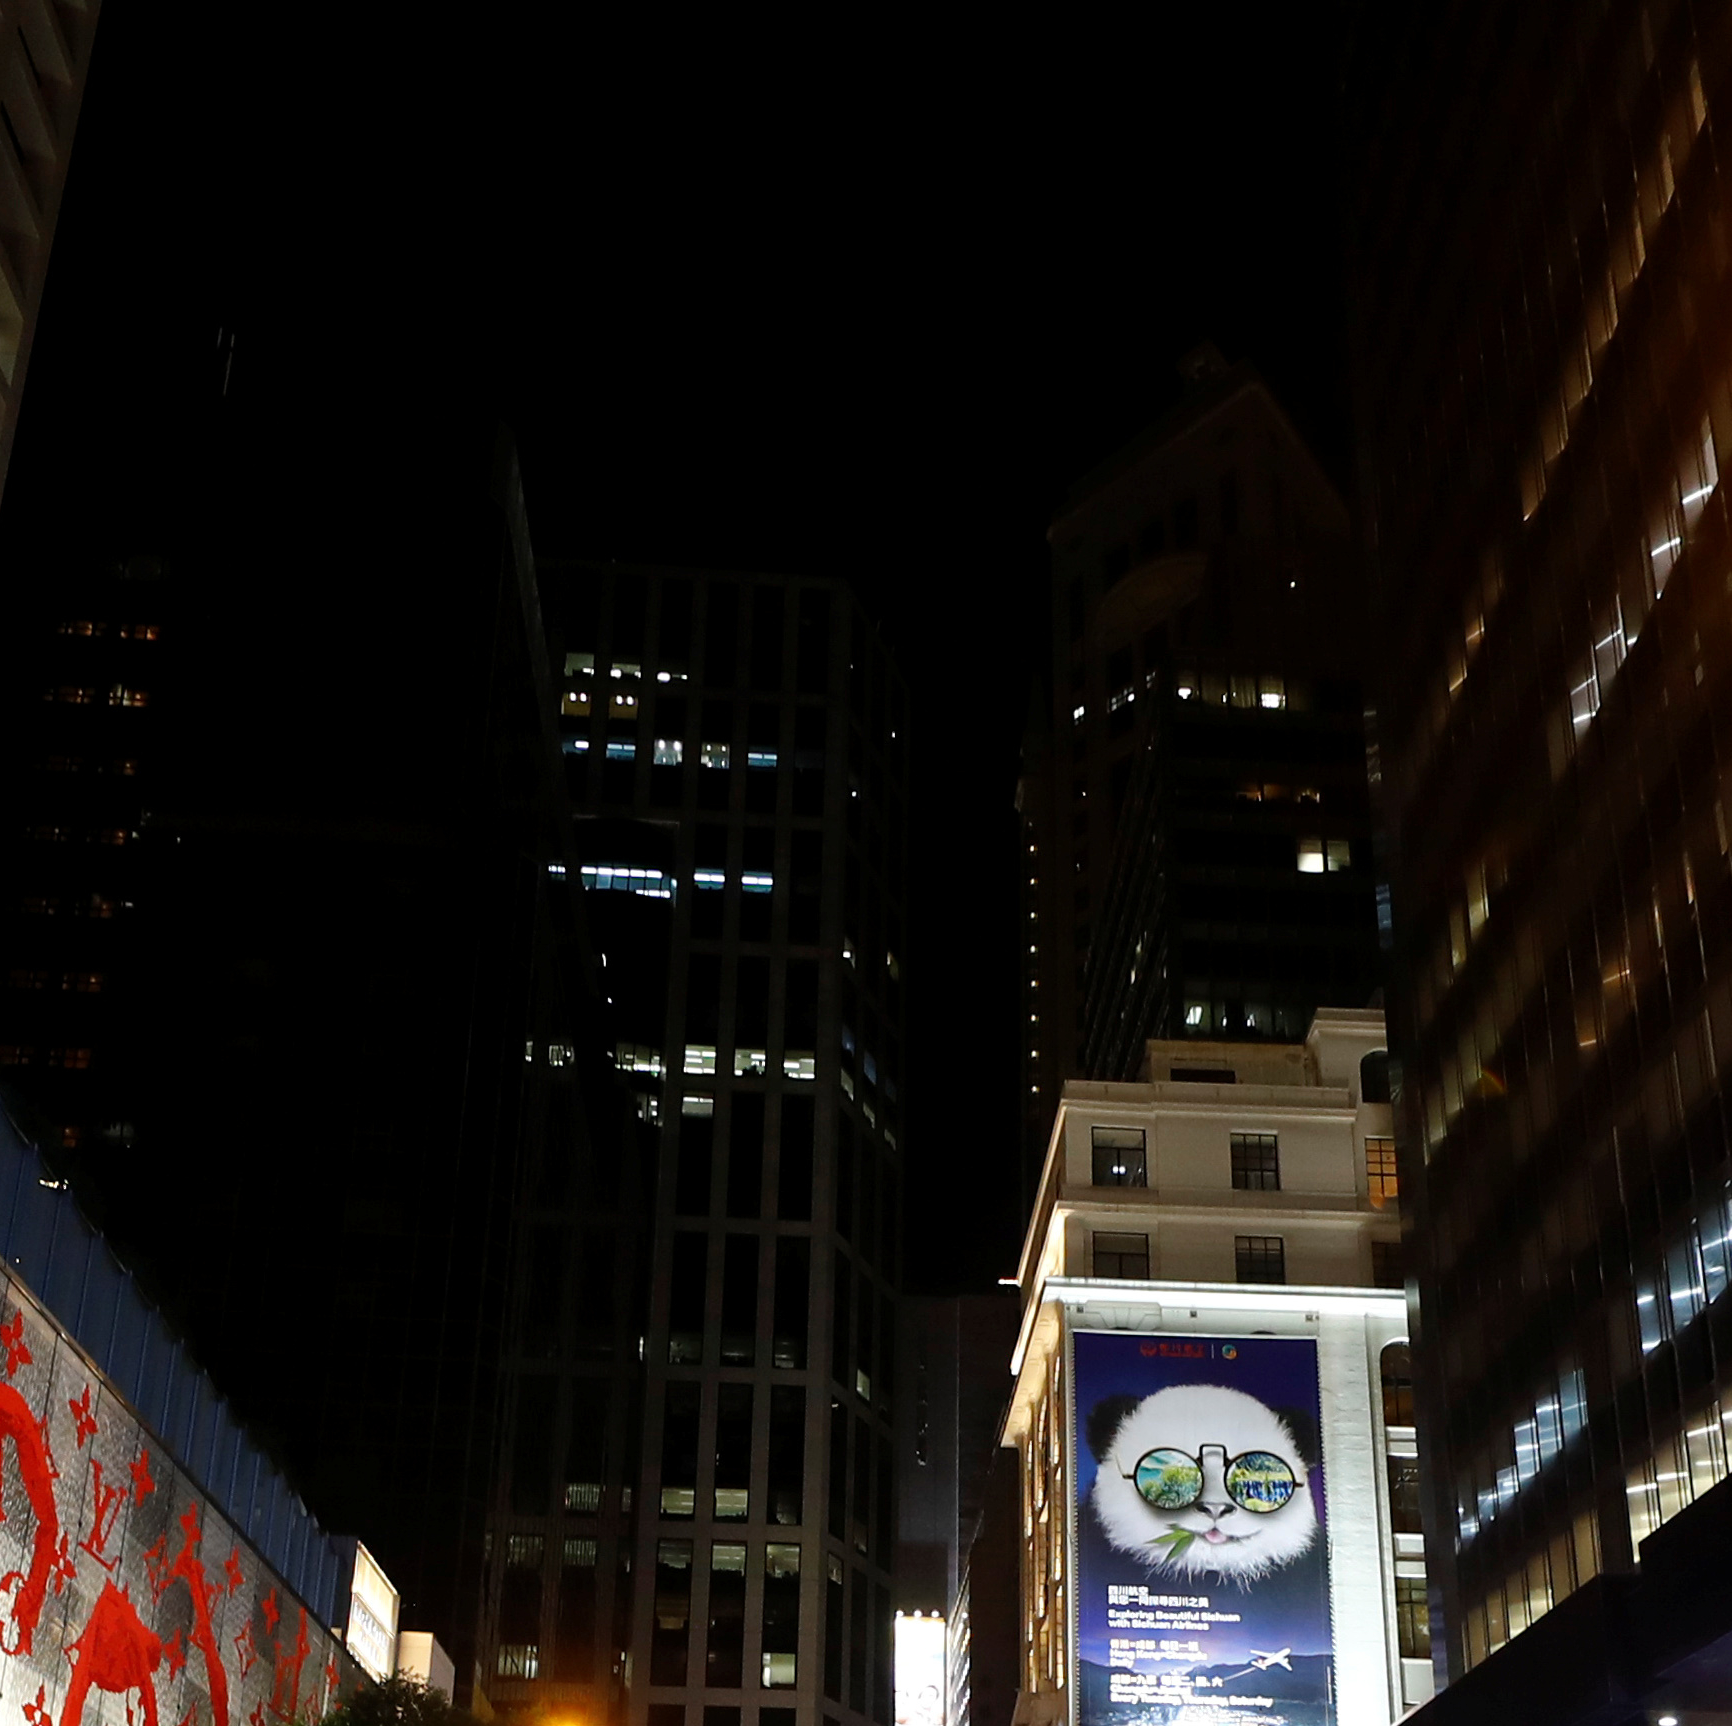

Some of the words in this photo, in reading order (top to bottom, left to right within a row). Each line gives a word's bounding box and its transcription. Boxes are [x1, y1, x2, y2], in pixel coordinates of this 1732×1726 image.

[1108, 1609, 1155, 1622] Exploring
[1156, 1611, 1199, 1622] Beautiful
[1201, 1612, 1241, 1622] Sichuan
[1108, 1619, 1130, 1629] with
[1132, 1620, 1172, 1630] Sichuan
[1172, 1620, 1209, 1631] Airlines
